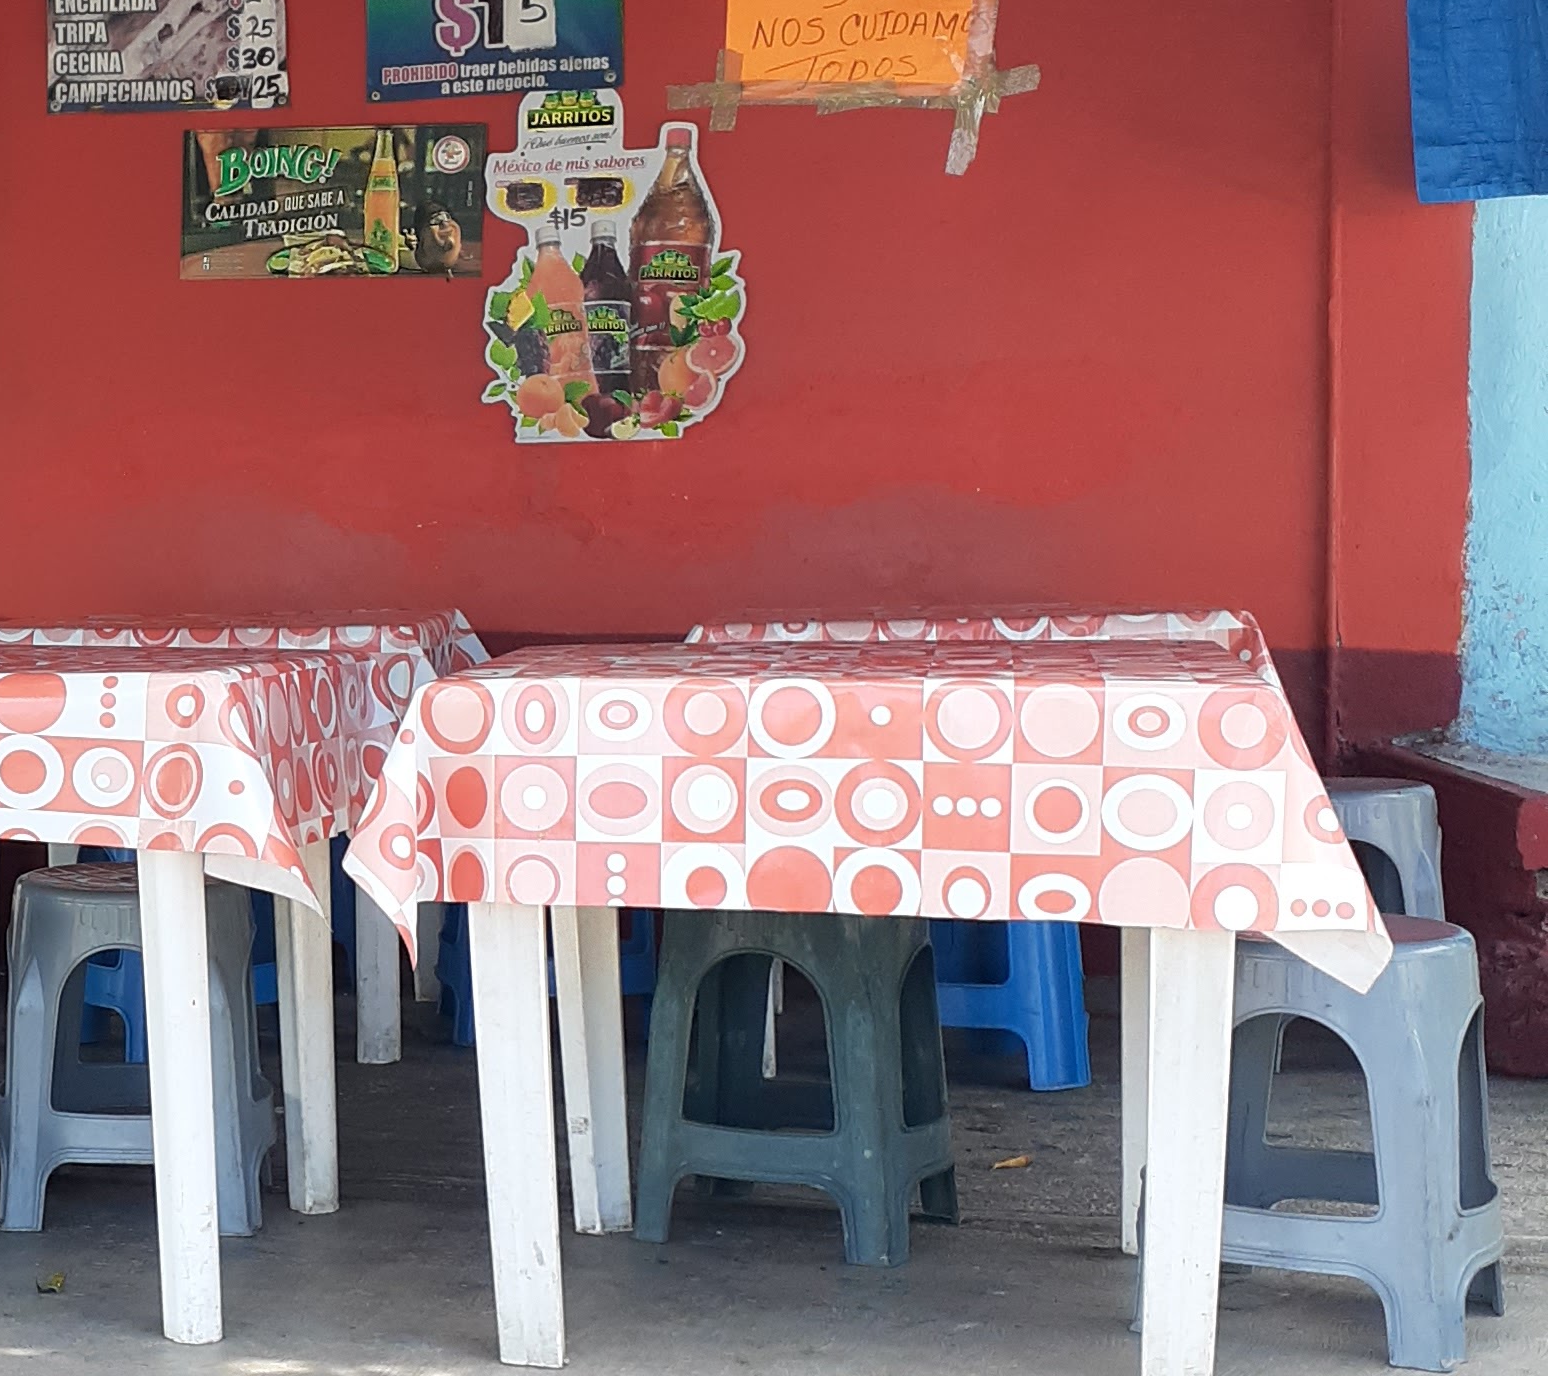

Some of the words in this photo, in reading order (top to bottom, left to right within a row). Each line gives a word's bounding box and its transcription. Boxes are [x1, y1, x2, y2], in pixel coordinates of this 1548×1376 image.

[56, 22, 107, 45] TRIPA
[752, 16, 826, 50] NOS
[55, 51, 124, 75] CECINA
[382, 63, 458, 85] PROHIBIDO
[460, 61, 495, 78] traer
[498, 57, 557, 75] bebidas
[559, 55, 610, 74] ajenas
[764, 48, 918, 91] TODOS
[55, 80, 195, 105] CAMPECHANOS
[441, 83, 451, 95] a
[452, 79, 484, 94] este
[487, 74, 549, 96] negocio.
[530, 109, 612, 126] JARRITOS
[214, 143, 342, 196] BOING!
[493, 156, 542, 174] México
[545, 154, 562, 171] de
[565, 154, 591, 170] mis
[593, 153, 646, 170] sabores
[205, 199, 279, 222] CALIDAD
[284, 196, 305, 212] QUE
[307, 191, 333, 210] SABE
[336, 189, 345, 206] A
[547, 207, 588, 230] $15
